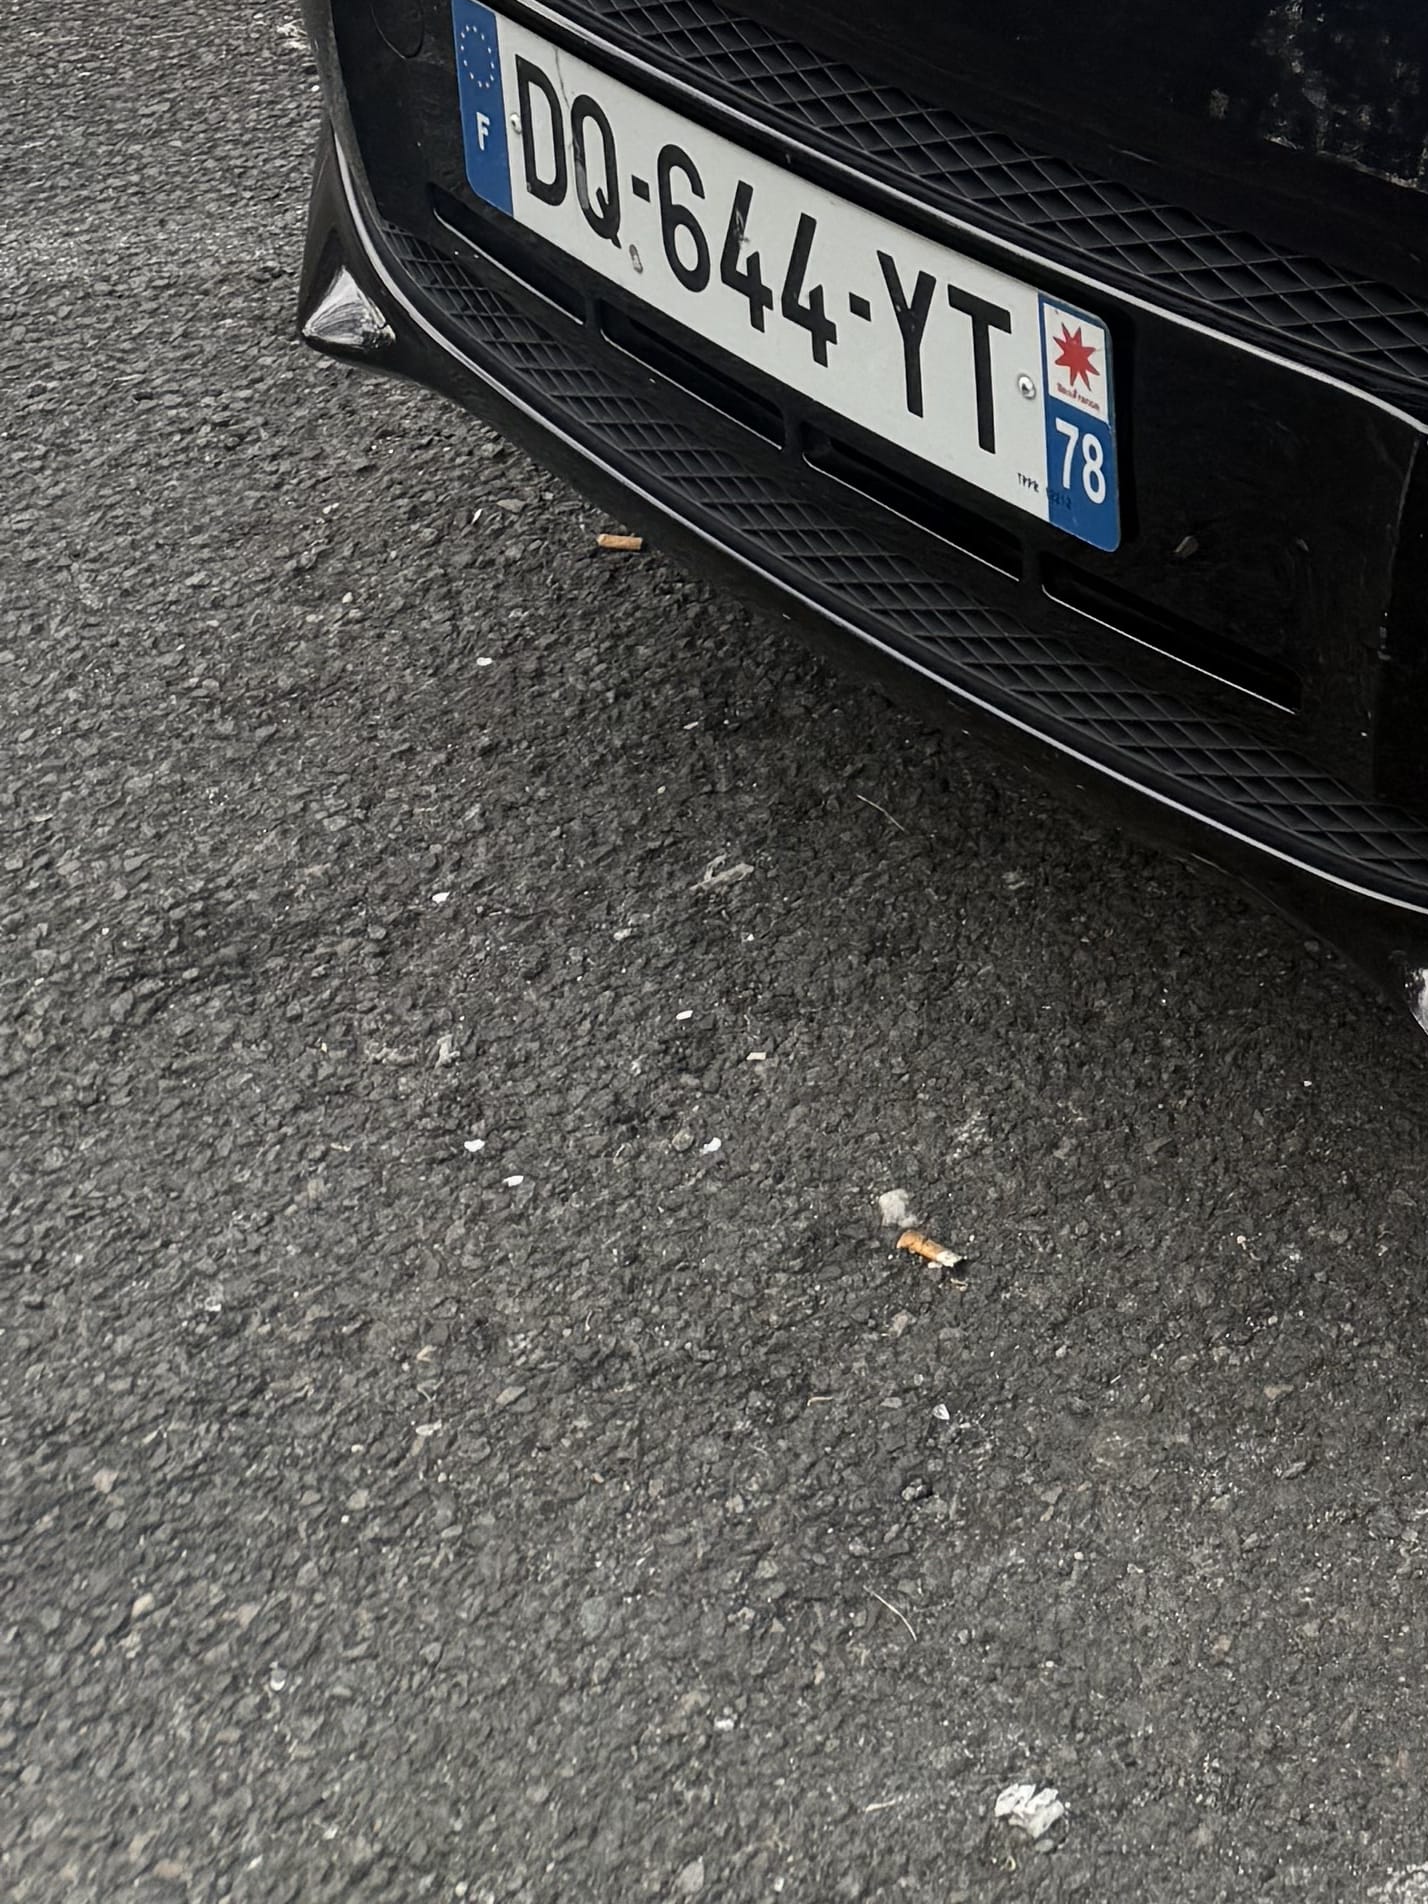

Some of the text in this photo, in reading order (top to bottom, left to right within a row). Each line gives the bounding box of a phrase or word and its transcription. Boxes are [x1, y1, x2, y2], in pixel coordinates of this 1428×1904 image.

[475, 110, 491, 151] F
[515, 53, 1013, 455] DQ-644-YT
[1055, 416, 1107, 505] 78
